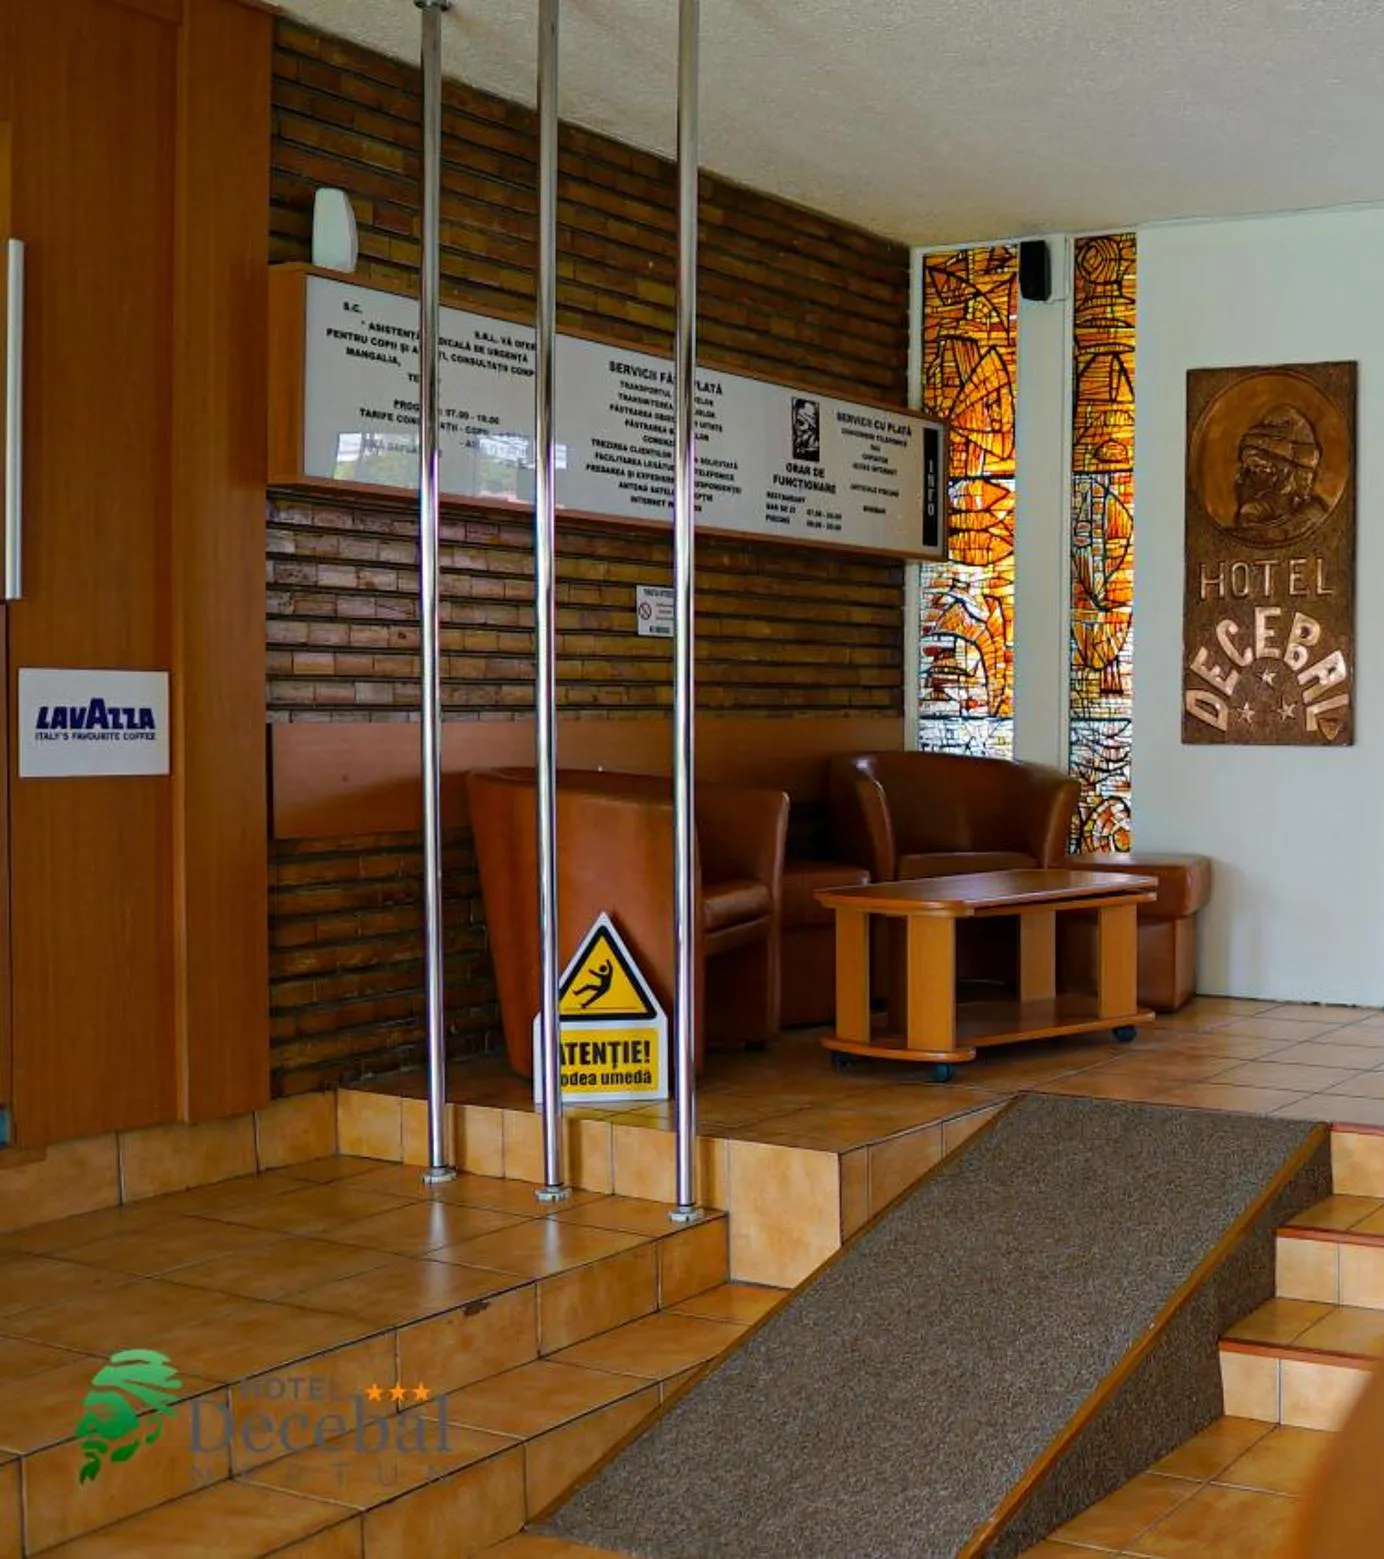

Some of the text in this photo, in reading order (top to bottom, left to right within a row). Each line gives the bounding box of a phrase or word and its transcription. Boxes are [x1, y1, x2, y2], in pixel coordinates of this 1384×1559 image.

[326, 328, 368, 344] PENTRU
[514, 340, 536, 351] OFER
[609, 361, 658, 381] SERVICII
[694, 381, 723, 396] LATĂ
[1200, 558, 1335, 600] HOTEL
[1184, 606, 1350, 732] DECEBAL
[35, 697, 156, 730] LAVAZZA
[71, 731, 121, 742] FAVOURITE
[123, 731, 156, 742] COFFEE
[560, 1072, 597, 1086] odea
